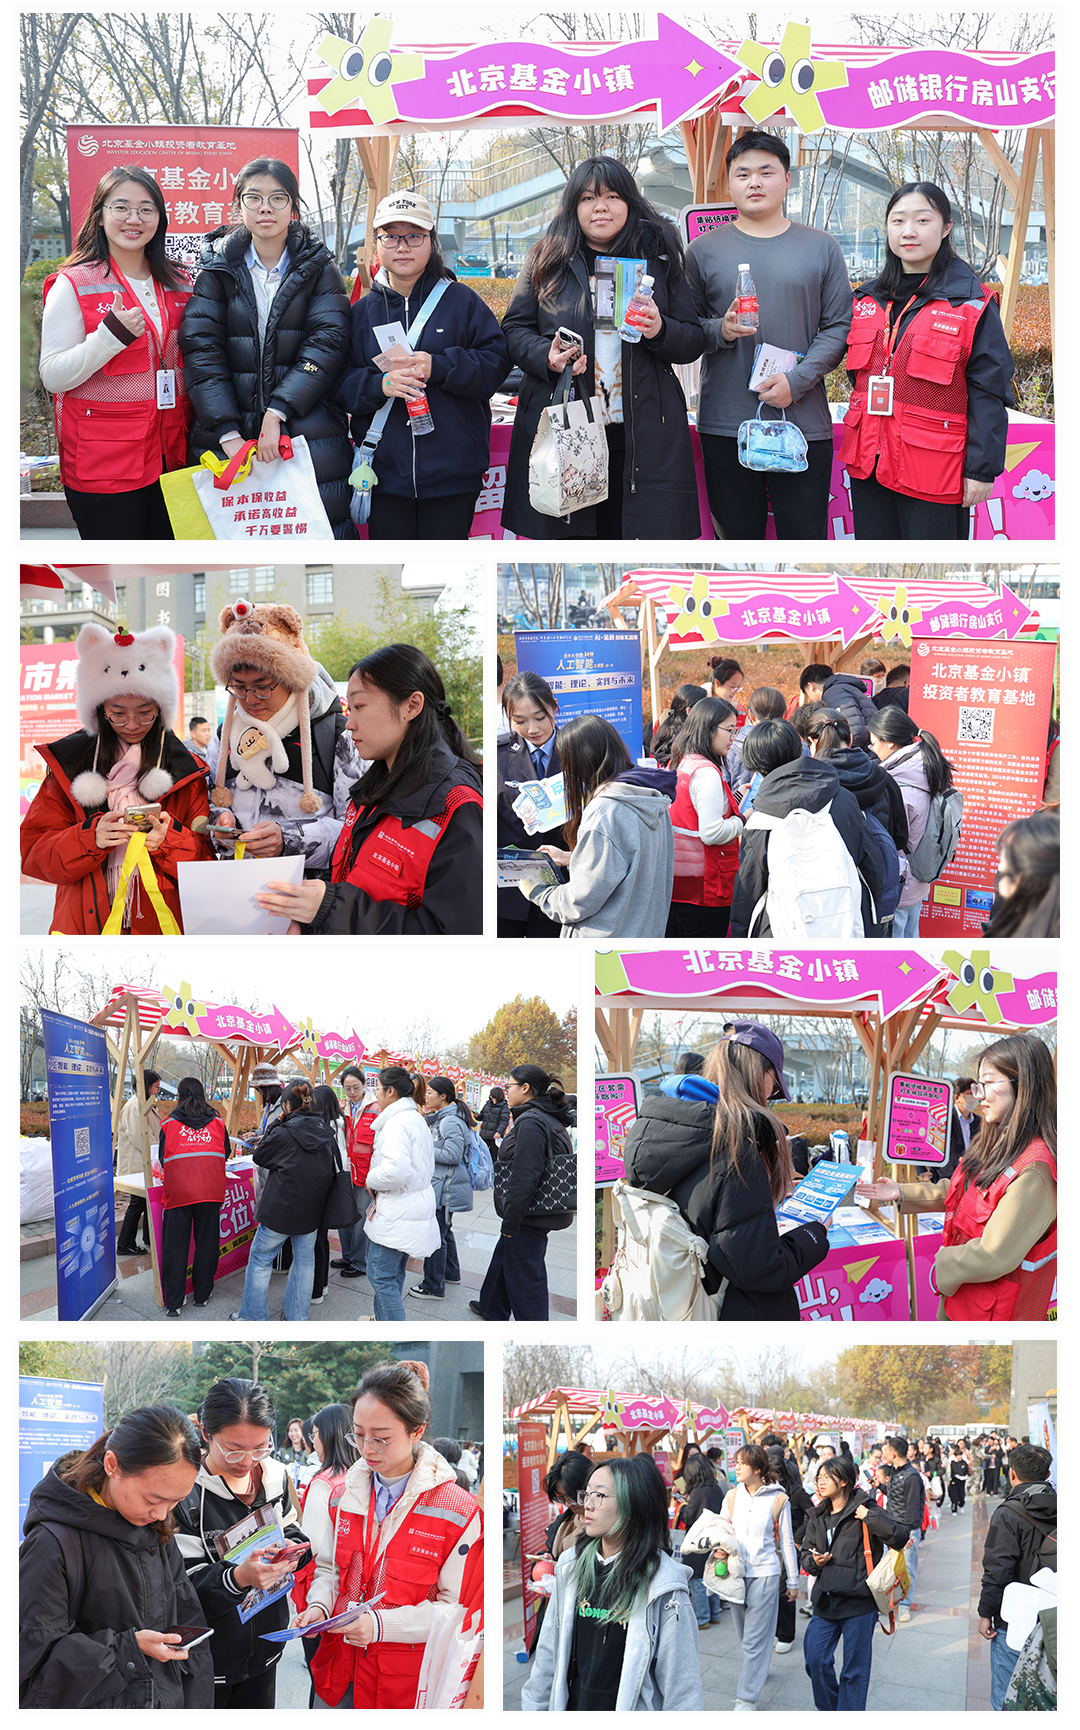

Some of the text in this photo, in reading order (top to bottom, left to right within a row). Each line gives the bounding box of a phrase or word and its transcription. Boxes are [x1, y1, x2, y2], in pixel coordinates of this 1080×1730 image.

[446, 63, 635, 98] 北京基金小镇
[221, 491, 287, 507] 保本保收益
[233, 507, 297, 522] 承诺高收益
[245, 523, 307, 536] 千万要警惕
[741, 606, 831, 627] 北京基金小镇
[929, 609, 1003, 633] 邮储银行房山支行
[556, 659, 594, 671] 人工智能
[931, 662, 1029, 684] 北京基金小镇
[43, 692, 74, 700] MARKET
[922, 683, 1036, 706] 投资者教育基地
[681, 950, 861, 983] 北京基金小镇
[1026, 987, 1057, 1011] 邮储
[215, 1014, 273, 1035] 北京基金小镇
[30, 1396, 63, 1407] 人工智能
